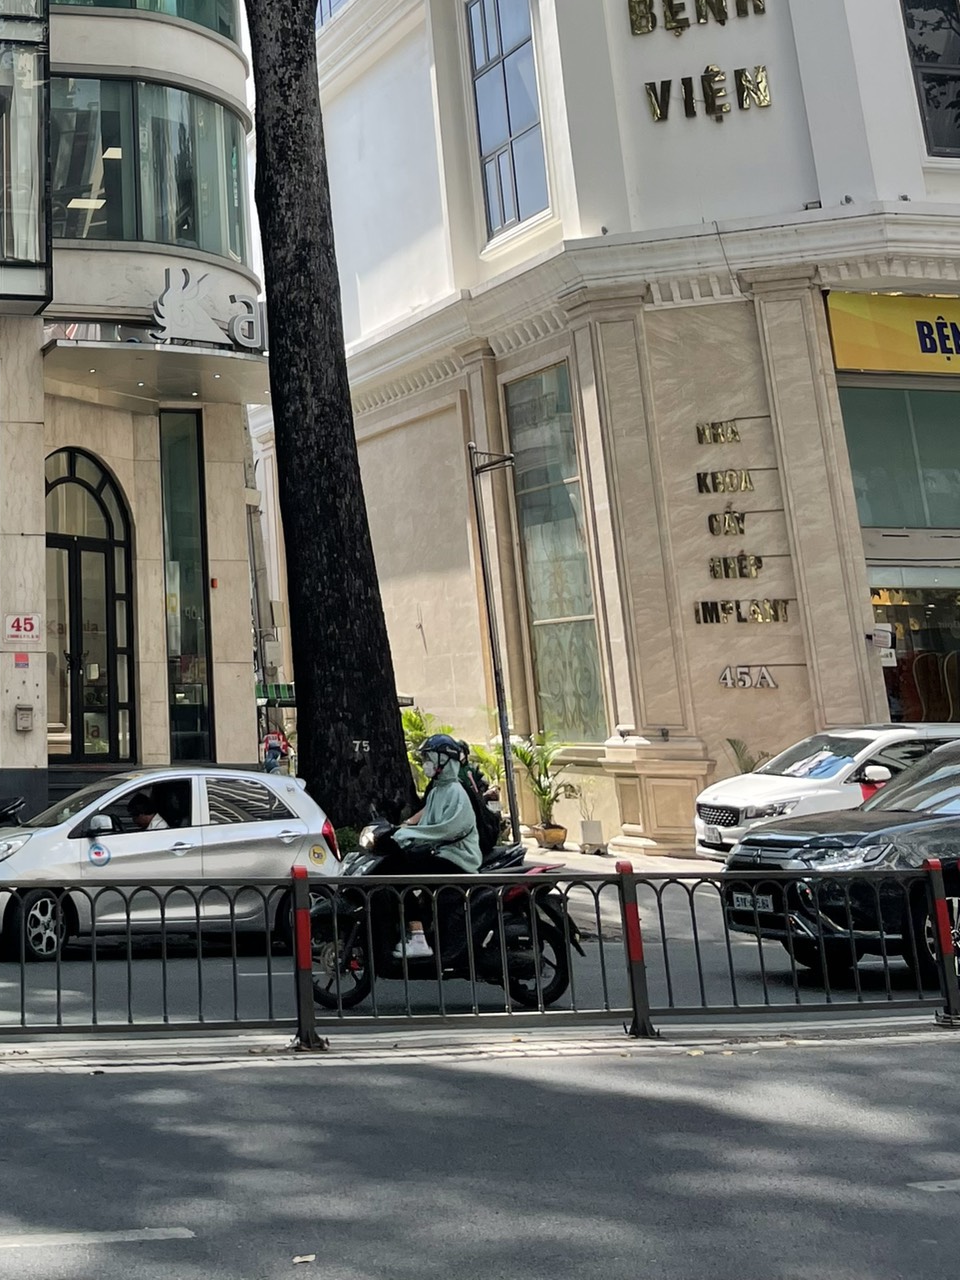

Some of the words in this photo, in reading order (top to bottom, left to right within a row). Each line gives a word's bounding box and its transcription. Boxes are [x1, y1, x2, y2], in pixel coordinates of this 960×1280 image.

[644, 64, 772, 122] VIỆN
[696, 468, 754, 494] KHOA
[693, 598, 789, 624] IMPLANT
[11, 617, 35, 632] 45
[719, 665, 778, 689] 45A
[352, 740, 370, 752] 75
